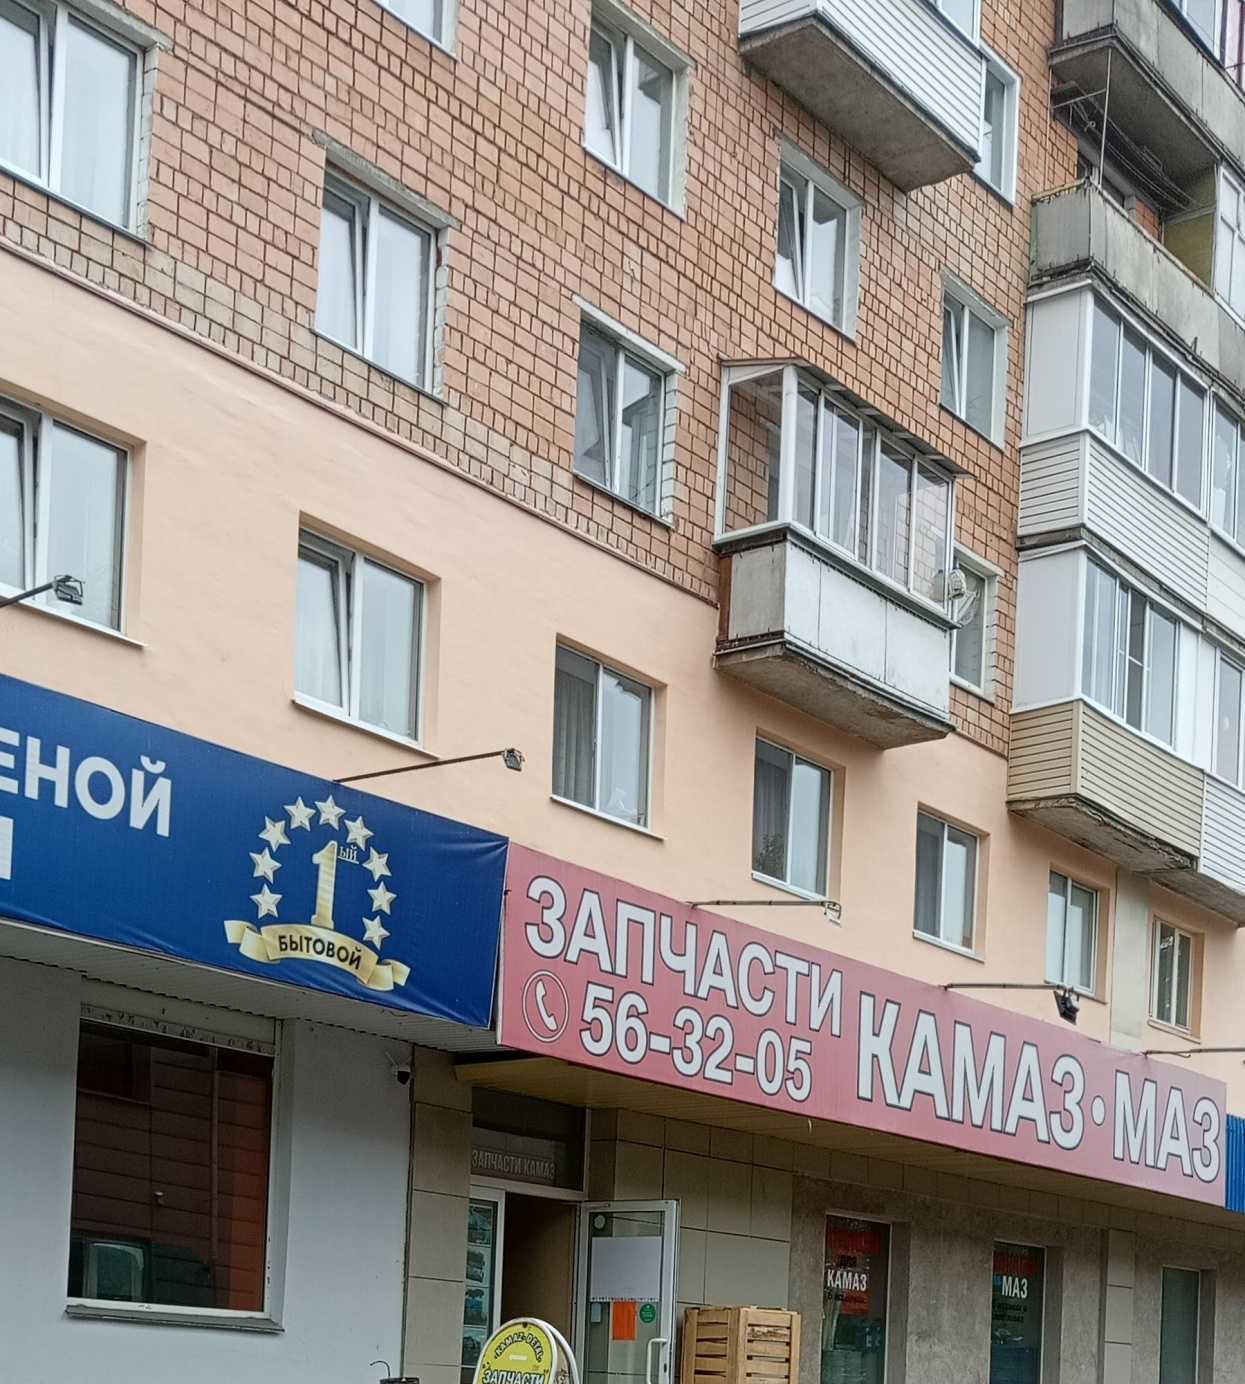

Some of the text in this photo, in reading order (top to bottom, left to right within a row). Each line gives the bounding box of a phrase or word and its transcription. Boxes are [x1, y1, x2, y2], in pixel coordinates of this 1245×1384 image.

[278, 934, 362, 970] БЫТОВОЙ
[525, 875, 843, 1038] ЗАПЧАСТИ
[580, 981, 812, 1102] 56-32-05
[857, 991, 1220, 1184] КАМАЗ МАЗ
[471, 1149, 556, 1178] ЗАПЧАСТИ КАМАЗ
[827, 1269, 867, 1292] КАМАЗ
[1002, 1275, 1028, 1299] МАЗ
